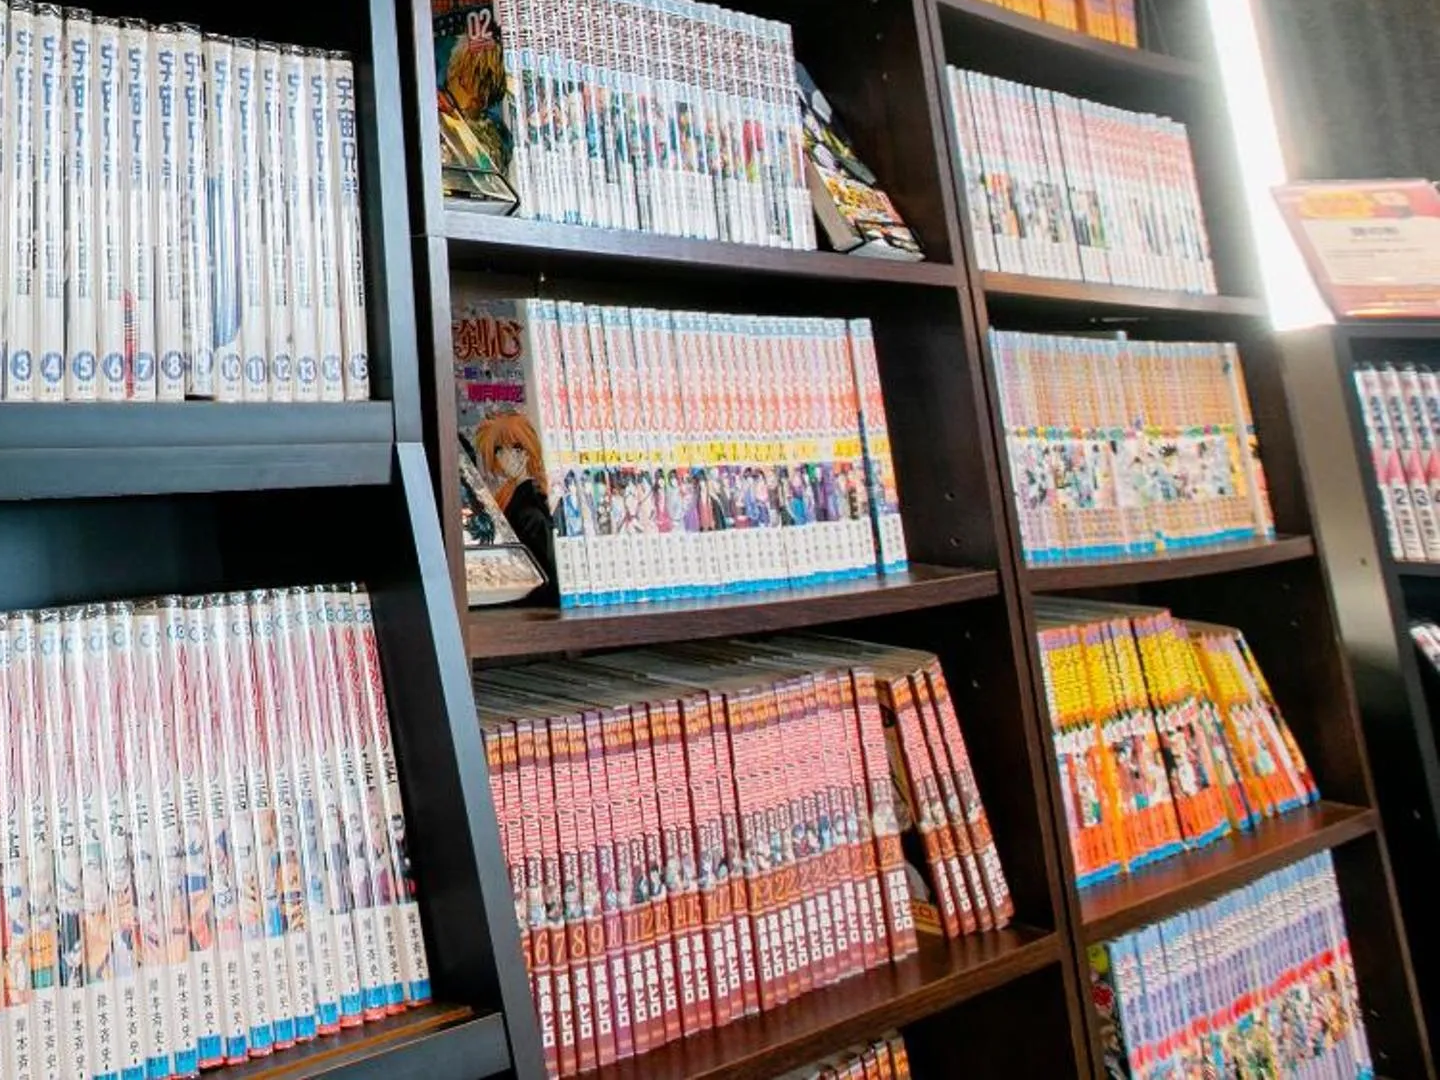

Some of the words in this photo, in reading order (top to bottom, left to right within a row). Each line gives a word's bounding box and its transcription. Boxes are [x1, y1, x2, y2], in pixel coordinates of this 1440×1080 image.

[467, 8, 493, 39] 02
[1394, 488, 1406, 506] 2
[1416, 488, 1428, 507] 3
